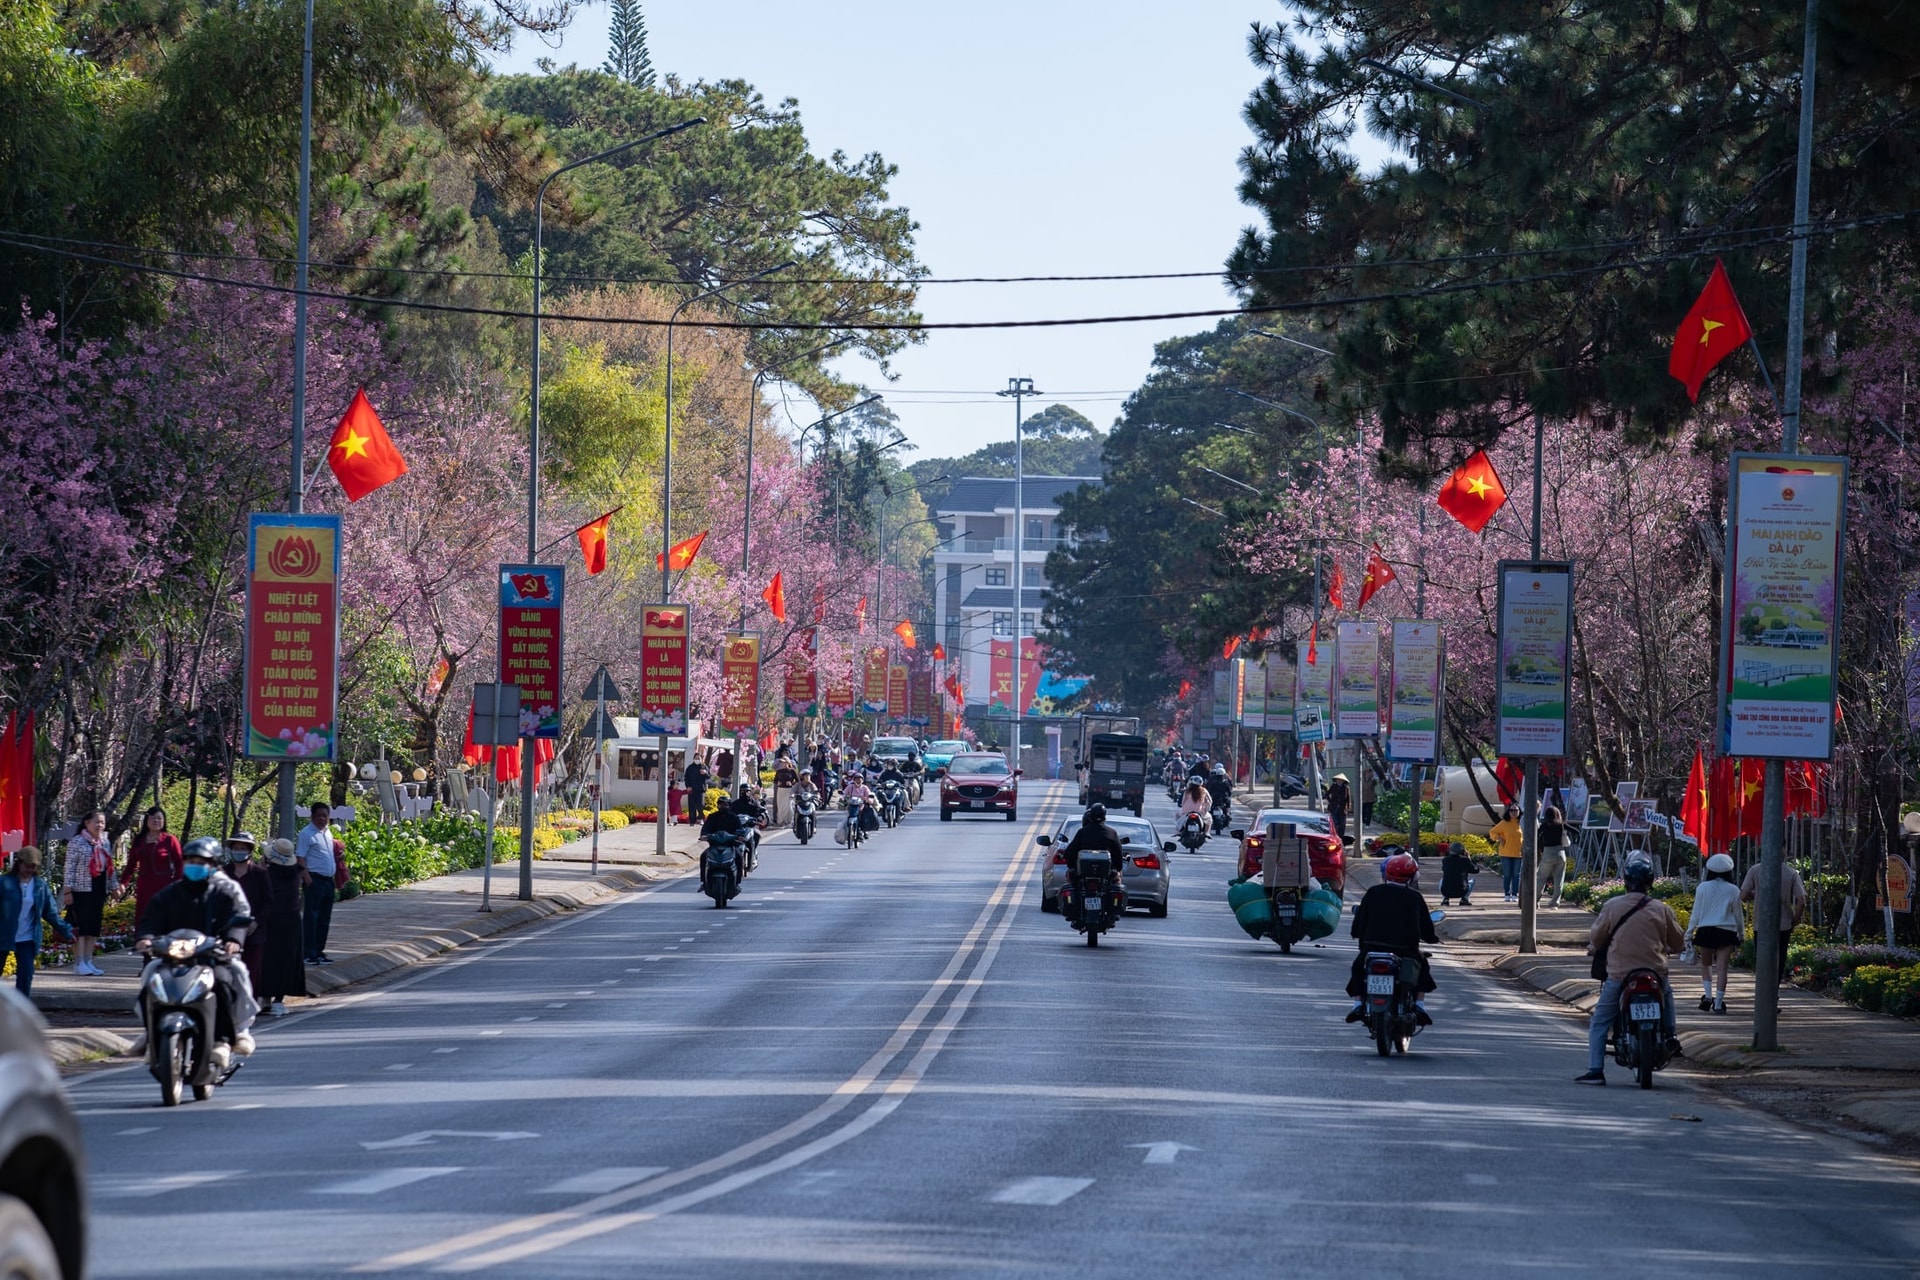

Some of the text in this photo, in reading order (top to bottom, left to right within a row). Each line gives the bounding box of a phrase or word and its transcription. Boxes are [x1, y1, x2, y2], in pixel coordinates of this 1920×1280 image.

[1752, 528, 1823, 541] MAI ANH ĐÀO
[1769, 541, 1805, 556] ĐÀ LẠT
[268, 591, 318, 608] NHIỆT LIỆT
[264, 609, 321, 624] CHÀO MỪNG
[521, 609, 541, 622] ĐẢNG
[1524, 616, 1534, 624] ĐÀ
[275, 629, 310, 645] ĐẠI HỘI
[508, 626, 553, 639] VỮNG MẠNH,
[512, 640, 548, 653] ĐẤT NƯỚC
[648, 638, 681, 648] NHÂN DÂN
[271, 645, 312, 663] ĐẠI BIỂU
[660, 652, 668, 662] LÀ
[508, 656, 552, 670] PHÁT TRIỂN,
[263, 664, 317, 681] TOÀN QUỐC
[646, 665, 682, 678] CỘI NGUỒN
[514, 673, 545, 686] DÂN TỘC
[646, 680, 680, 692] SỨC MẠNH
[261, 682, 318, 698] LẦN THỨ XIV
[536, 688, 552, 700] TỒN!
[646, 693, 681, 704] CỦA ĐẢNG!
[264, 702, 316, 717] CỦA ĐẢNG!
